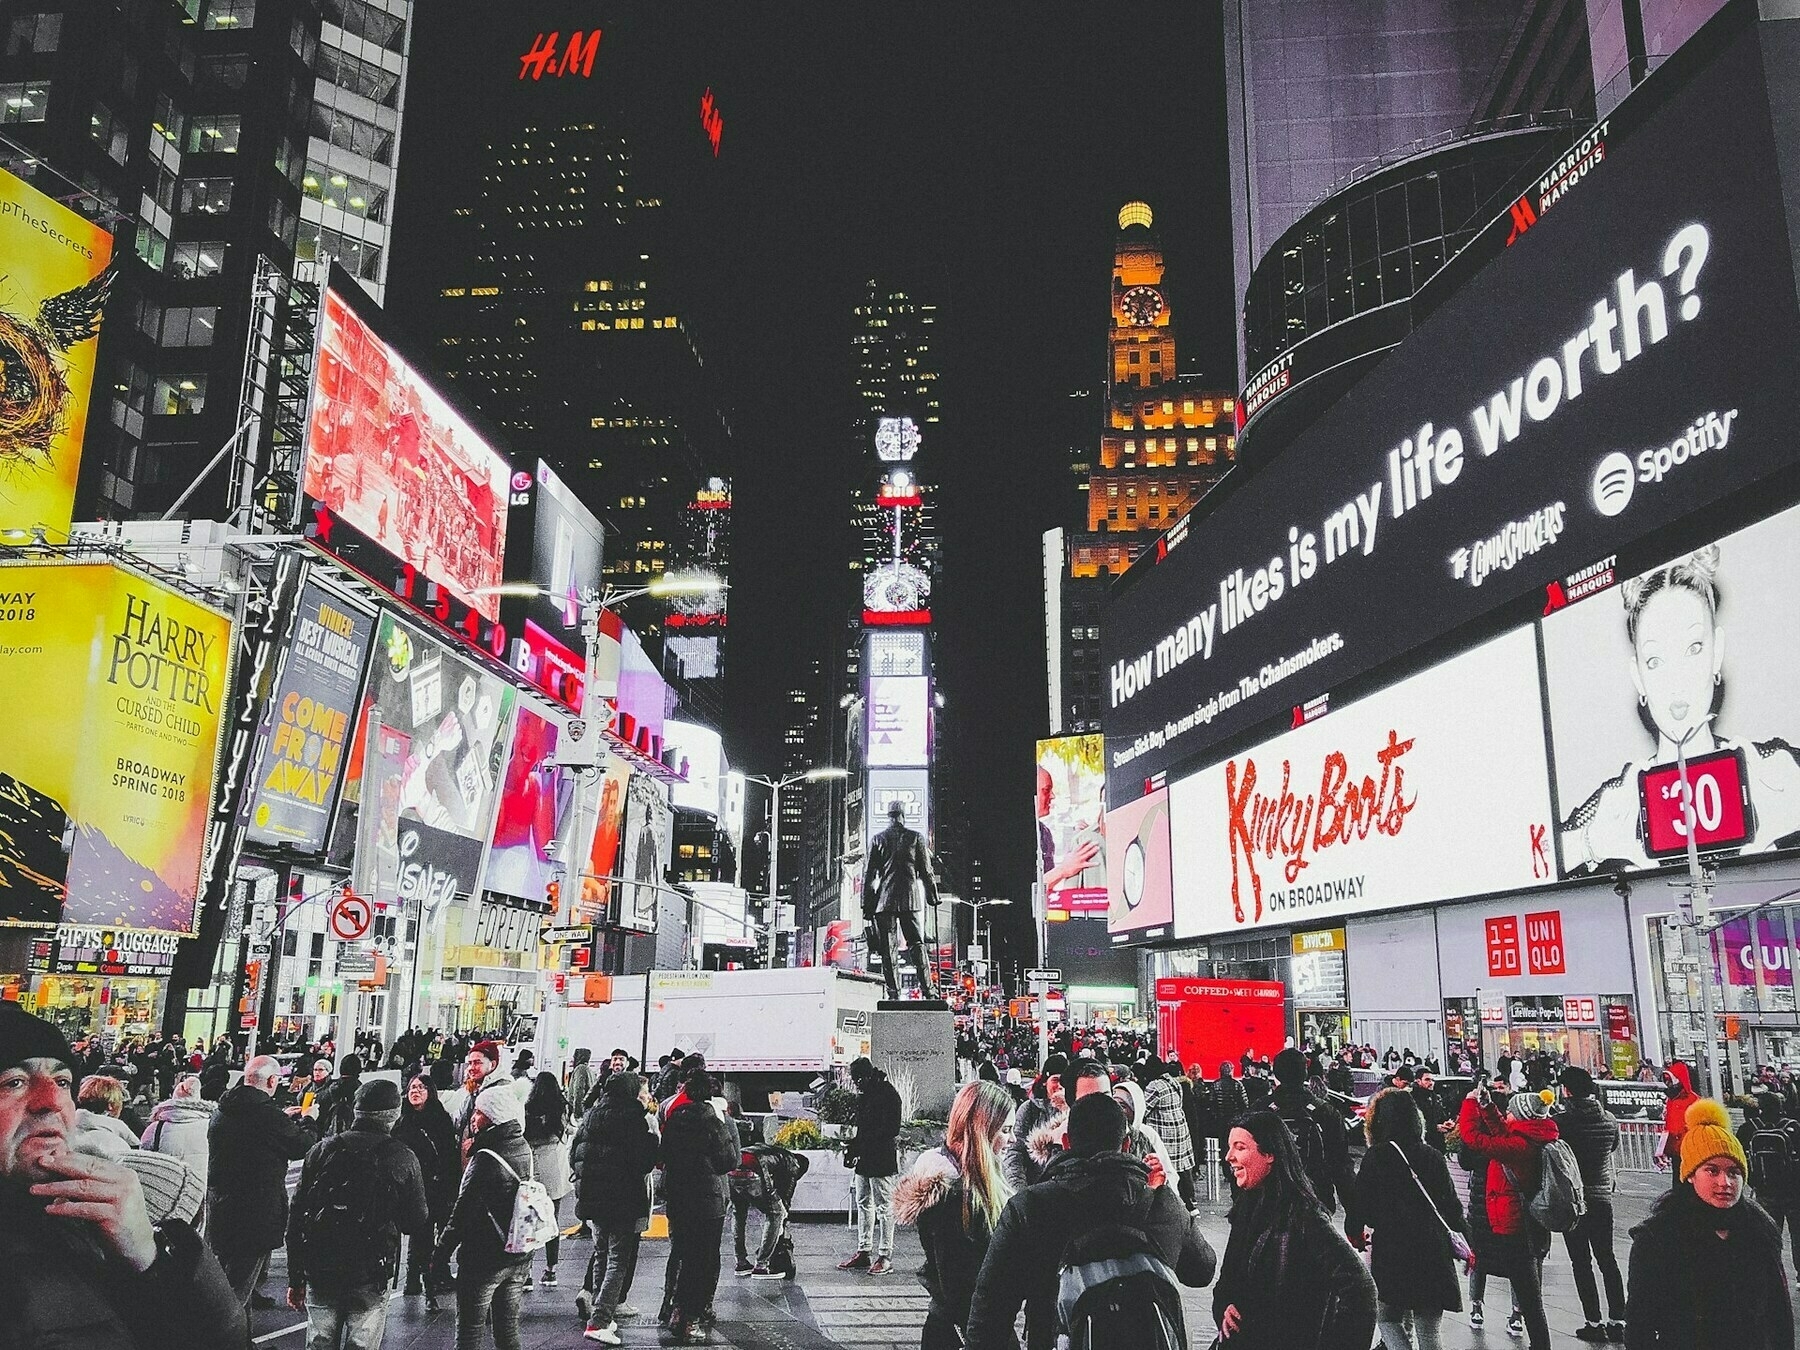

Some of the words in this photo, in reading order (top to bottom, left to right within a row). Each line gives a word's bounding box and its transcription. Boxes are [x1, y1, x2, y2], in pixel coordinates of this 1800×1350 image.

[519, 29, 602, 81] H&M
[1540, 120, 1610, 195] MARRIOTT
[1542, 147, 1604, 212] MARQUIS
[1246, 352, 1295, 401] MARRIOTT
[1246, 373, 1288, 416] MARQUIS
[1111, 651, 1153, 708] How
[1155, 602, 1217, 662] many
[1220, 557, 1285, 636] likes
[1288, 526, 1318, 588] is
[1323, 482, 1383, 565] my
[1387, 422, 1464, 521] life
[1470, 222, 1710, 457] worth?
[1637, 409, 1738, 483] Spotify
[510, 493, 530, 506] LG
[1470, 501, 1567, 587] CHAINSMOKERS
[1566, 554, 1617, 587] MARRIOTT
[1568, 571, 1614, 600] MARQUIS
[402, 562, 507, 658] 1540
[121, 592, 217, 671] HARRY
[298, 617, 325, 650] BEST
[321, 629, 361, 669] MUSICAL
[106, 634, 214, 715] POTTER
[116, 696, 163, 725] CURSED
[165, 713, 201, 737] CHILD
[145, 695, 162, 708] AND
[163, 699, 176, 713] THE
[281, 690, 348, 743] COME
[1113, 745, 1136, 769] Stream
[1134, 733, 1150, 757] Sick
[1149, 729, 1166, 750] Boy,
[1165, 721, 1178, 741] the
[1177, 711, 1195, 735] new
[1194, 702, 1219, 726] single
[1218, 689, 1241, 713] from
[1239, 675, 1260, 701] The
[1259, 632, 1345, 690] Chainsmokers.
[126, 721, 144, 733] PARTS
[145, 725, 158, 737] ONE
[158, 732, 172, 742] AND
[173, 735, 187, 747] TWO
[272, 721, 342, 774] FROM
[111, 773, 158, 796] SPRING
[161, 786, 185, 803] 2018
[116, 757, 186, 786] BROADWAY
[262, 758, 335, 806] AWAY
[1226, 758, 1314, 924] Kinky
[1312, 729, 1419, 853] Boots
[711, 832, 720, 864] 1500
[397, 861, 458, 936] ISNEY
[1269, 888, 1286, 912] ON
[1289, 875, 1366, 909] BROADWAY
[55, 927, 102, 949] GIFTS
[113, 931, 180, 955] LUGGAGE
[554, 931, 569, 939] ONE
[571, 930, 586, 938] WAY
[1529, 920, 1556, 942] UNI
[100, 964, 126, 975] Canon
[128, 965, 153, 975] SONY
[1531, 945, 1561, 971] QLO
[1682, 963, 1692, 972] 46
[1183, 985, 1229, 997] COFFEED
[1606, 1089, 1667, 1100] BROADWAY'S
[1606, 1097, 1632, 1106] SURE
[1635, 1098, 1663, 1107] THING
